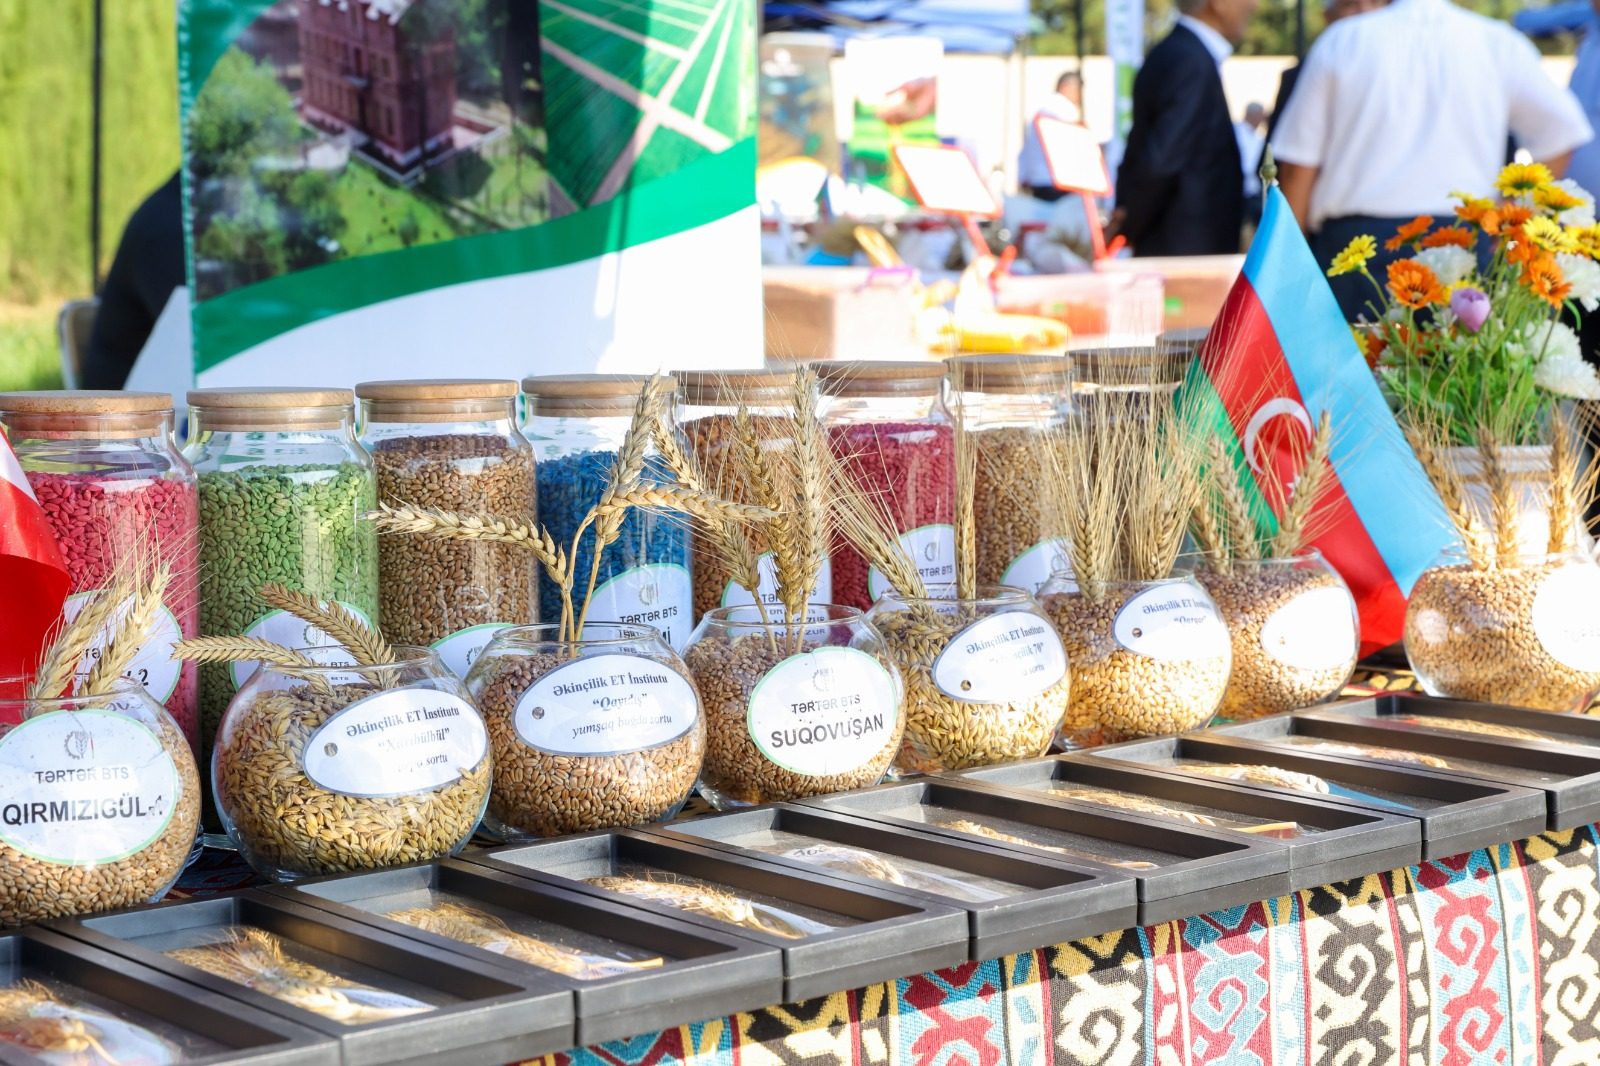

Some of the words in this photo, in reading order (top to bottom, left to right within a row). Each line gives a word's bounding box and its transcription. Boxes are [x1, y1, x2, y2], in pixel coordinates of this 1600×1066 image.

[662, 606, 678, 618] BTS
[1008, 629, 1022, 640] ET
[552, 676, 609, 697] Əkinçilik
[611, 674, 626, 686] ET
[628, 671, 668, 685] İnstitutu
[791, 698, 839, 715] TƏRTƏR
[840, 694, 861, 708] BTS
[346, 715, 404, 738] Əkinçilik
[406, 709, 422, 724] ET
[423, 706, 461, 721] İnstitutu
[770, 713, 885, 749] SUQOVUŞAN
[425, 753, 449, 768] sortu
[33, 768, 98, 785] TƏRTƏR
[101, 766, 130, 781] BTS
